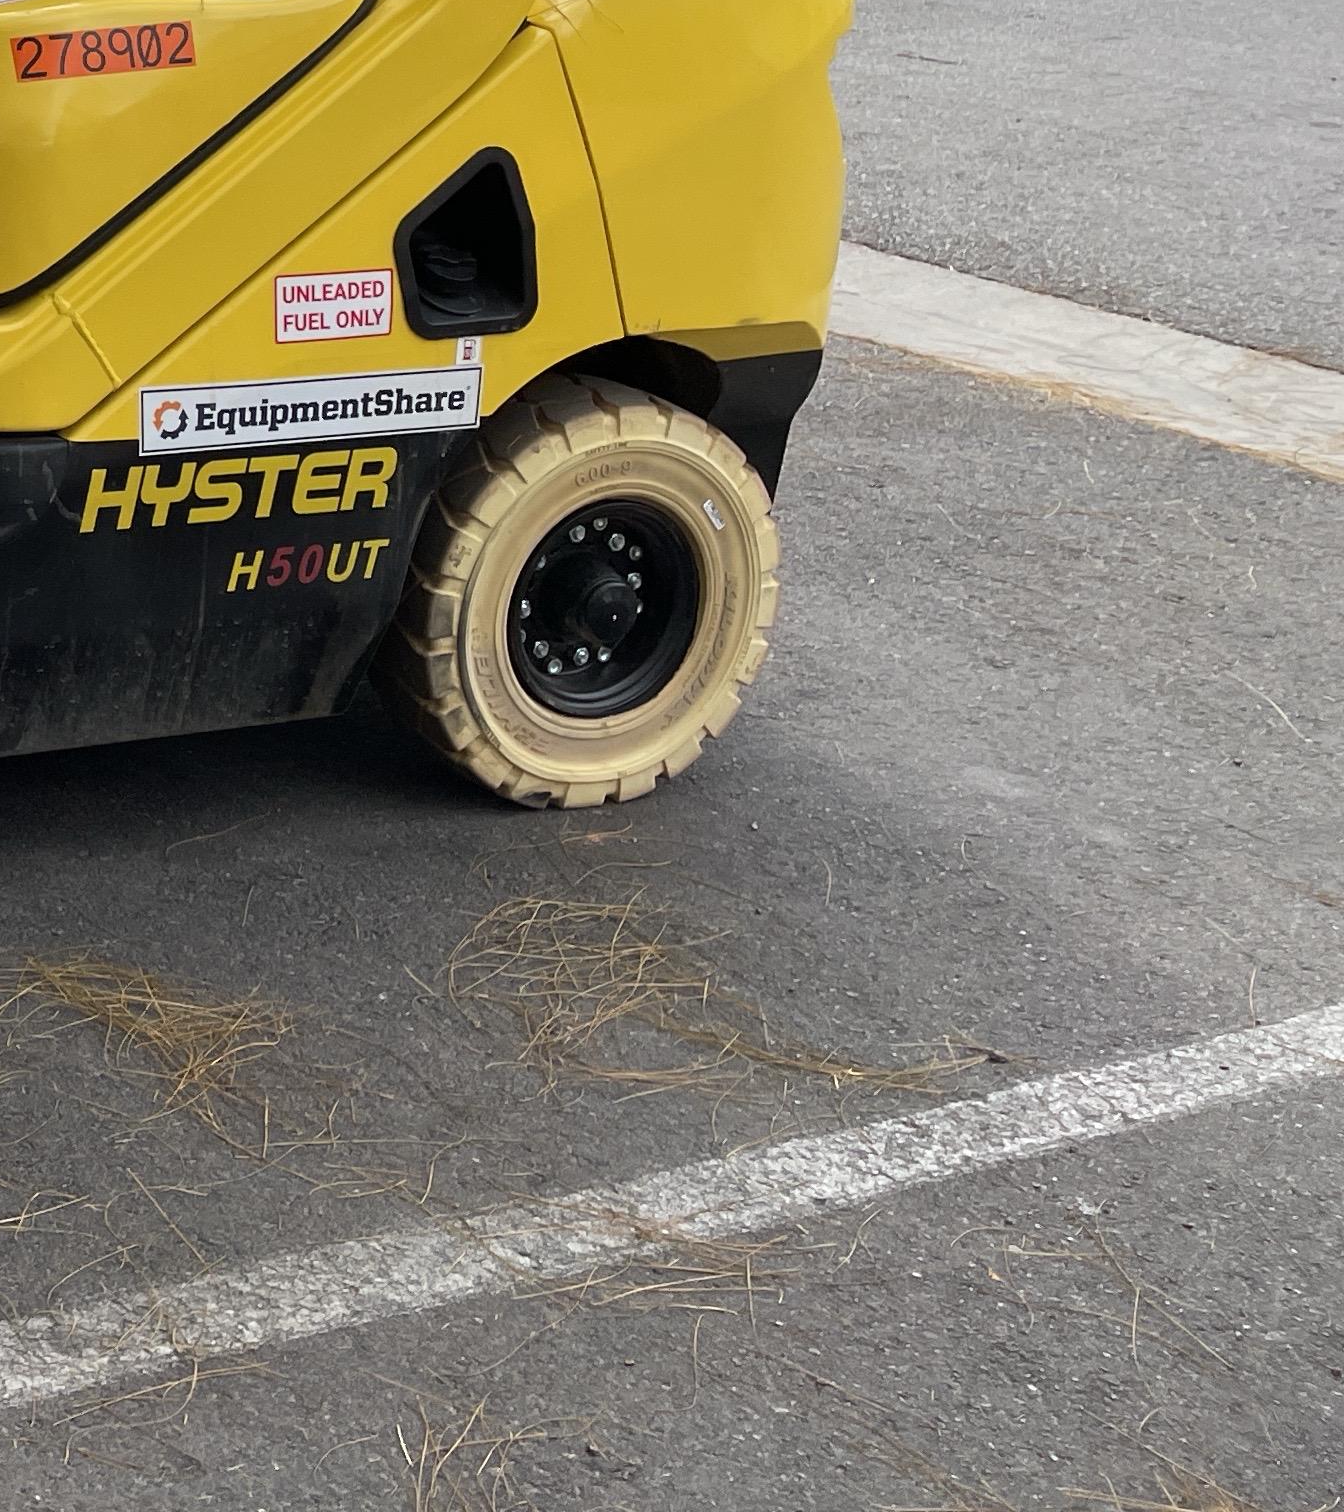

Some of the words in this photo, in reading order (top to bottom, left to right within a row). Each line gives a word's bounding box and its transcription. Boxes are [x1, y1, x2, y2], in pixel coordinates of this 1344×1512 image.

[15, 22, 194, 81] 278902
[283, 280, 385, 303] UNLEADED
[283, 312, 331, 332] FUEL
[336, 308, 385, 328] ONLY
[194, 388, 466, 434] EquipmentShare
[79, 446, 398, 534] HYSTER
[226, 538, 390, 592] H50UT
